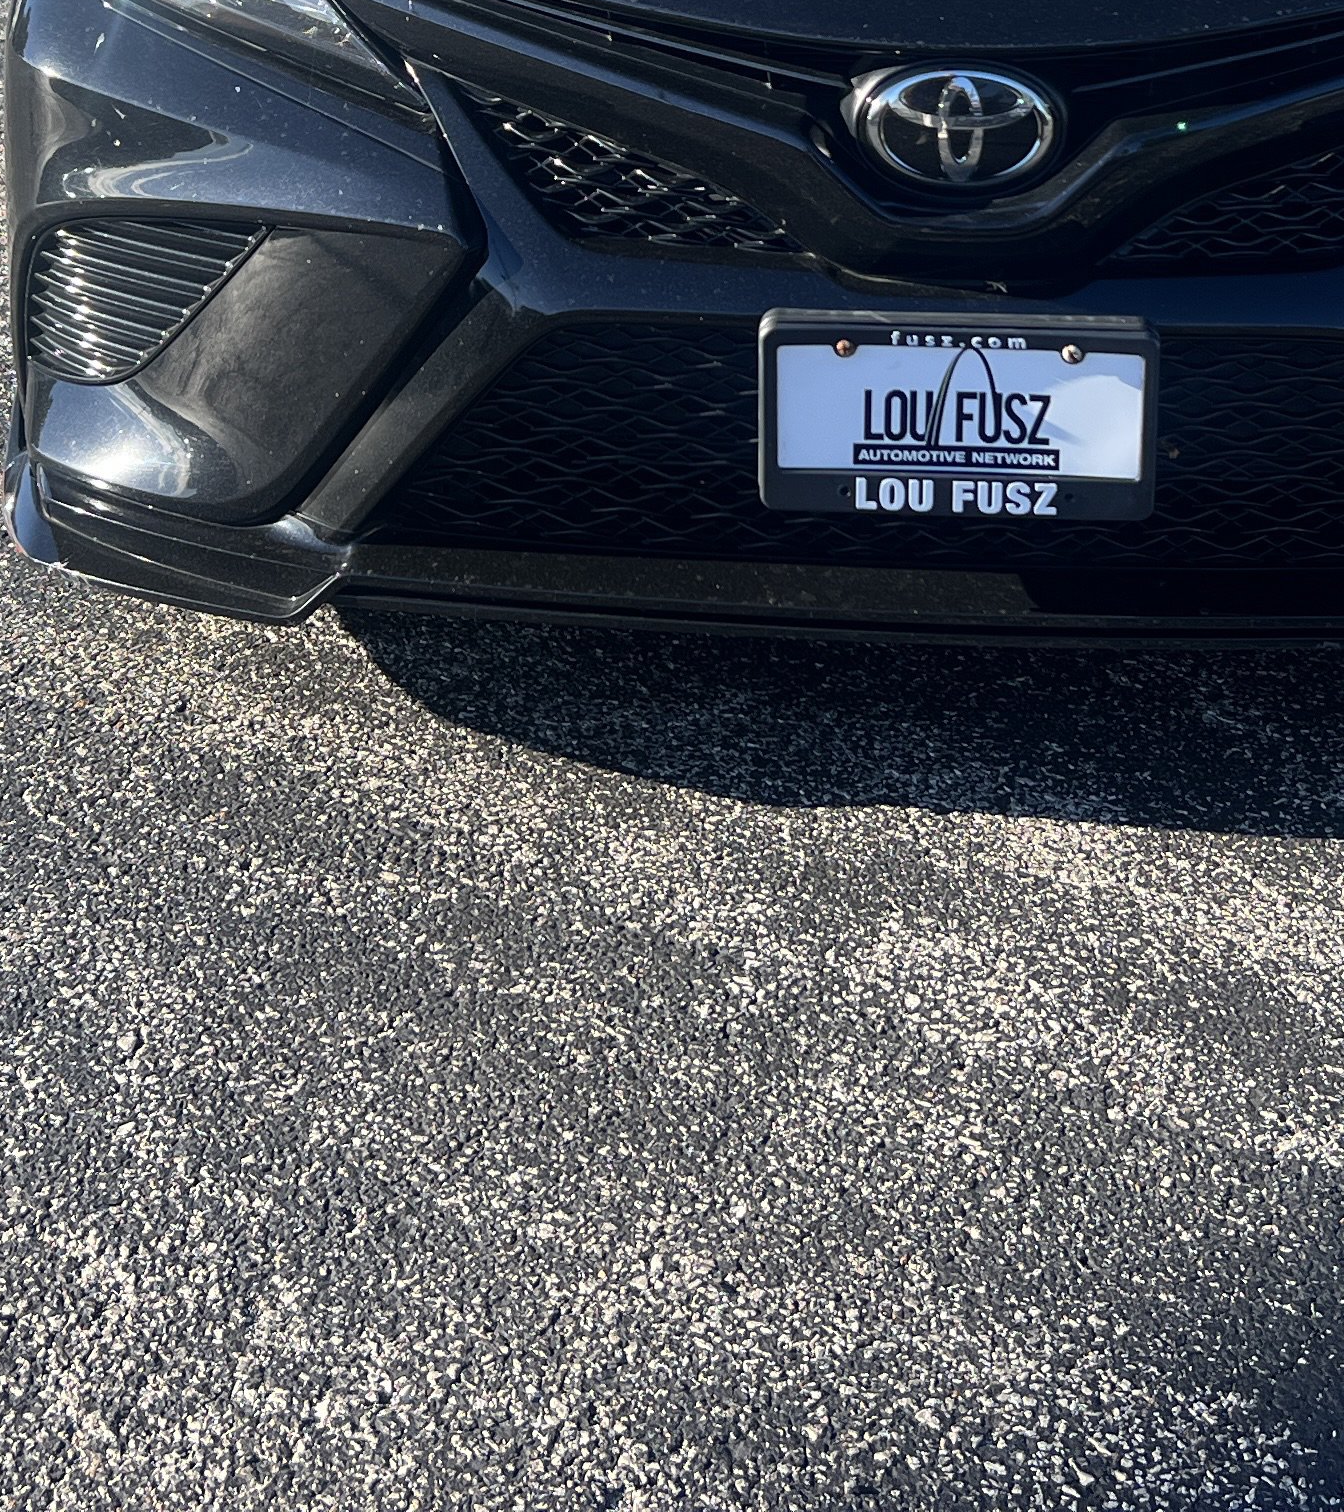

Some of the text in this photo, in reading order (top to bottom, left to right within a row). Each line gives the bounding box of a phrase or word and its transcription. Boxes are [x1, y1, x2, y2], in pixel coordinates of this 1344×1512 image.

[890, 330, 1028, 350] fusz.com
[864, 389, 1052, 445] LOU FUSZ
[857, 448, 1057, 467] AUTOMOTIVE NETWORK
[855, 476, 1058, 516] LOU FUSZ
